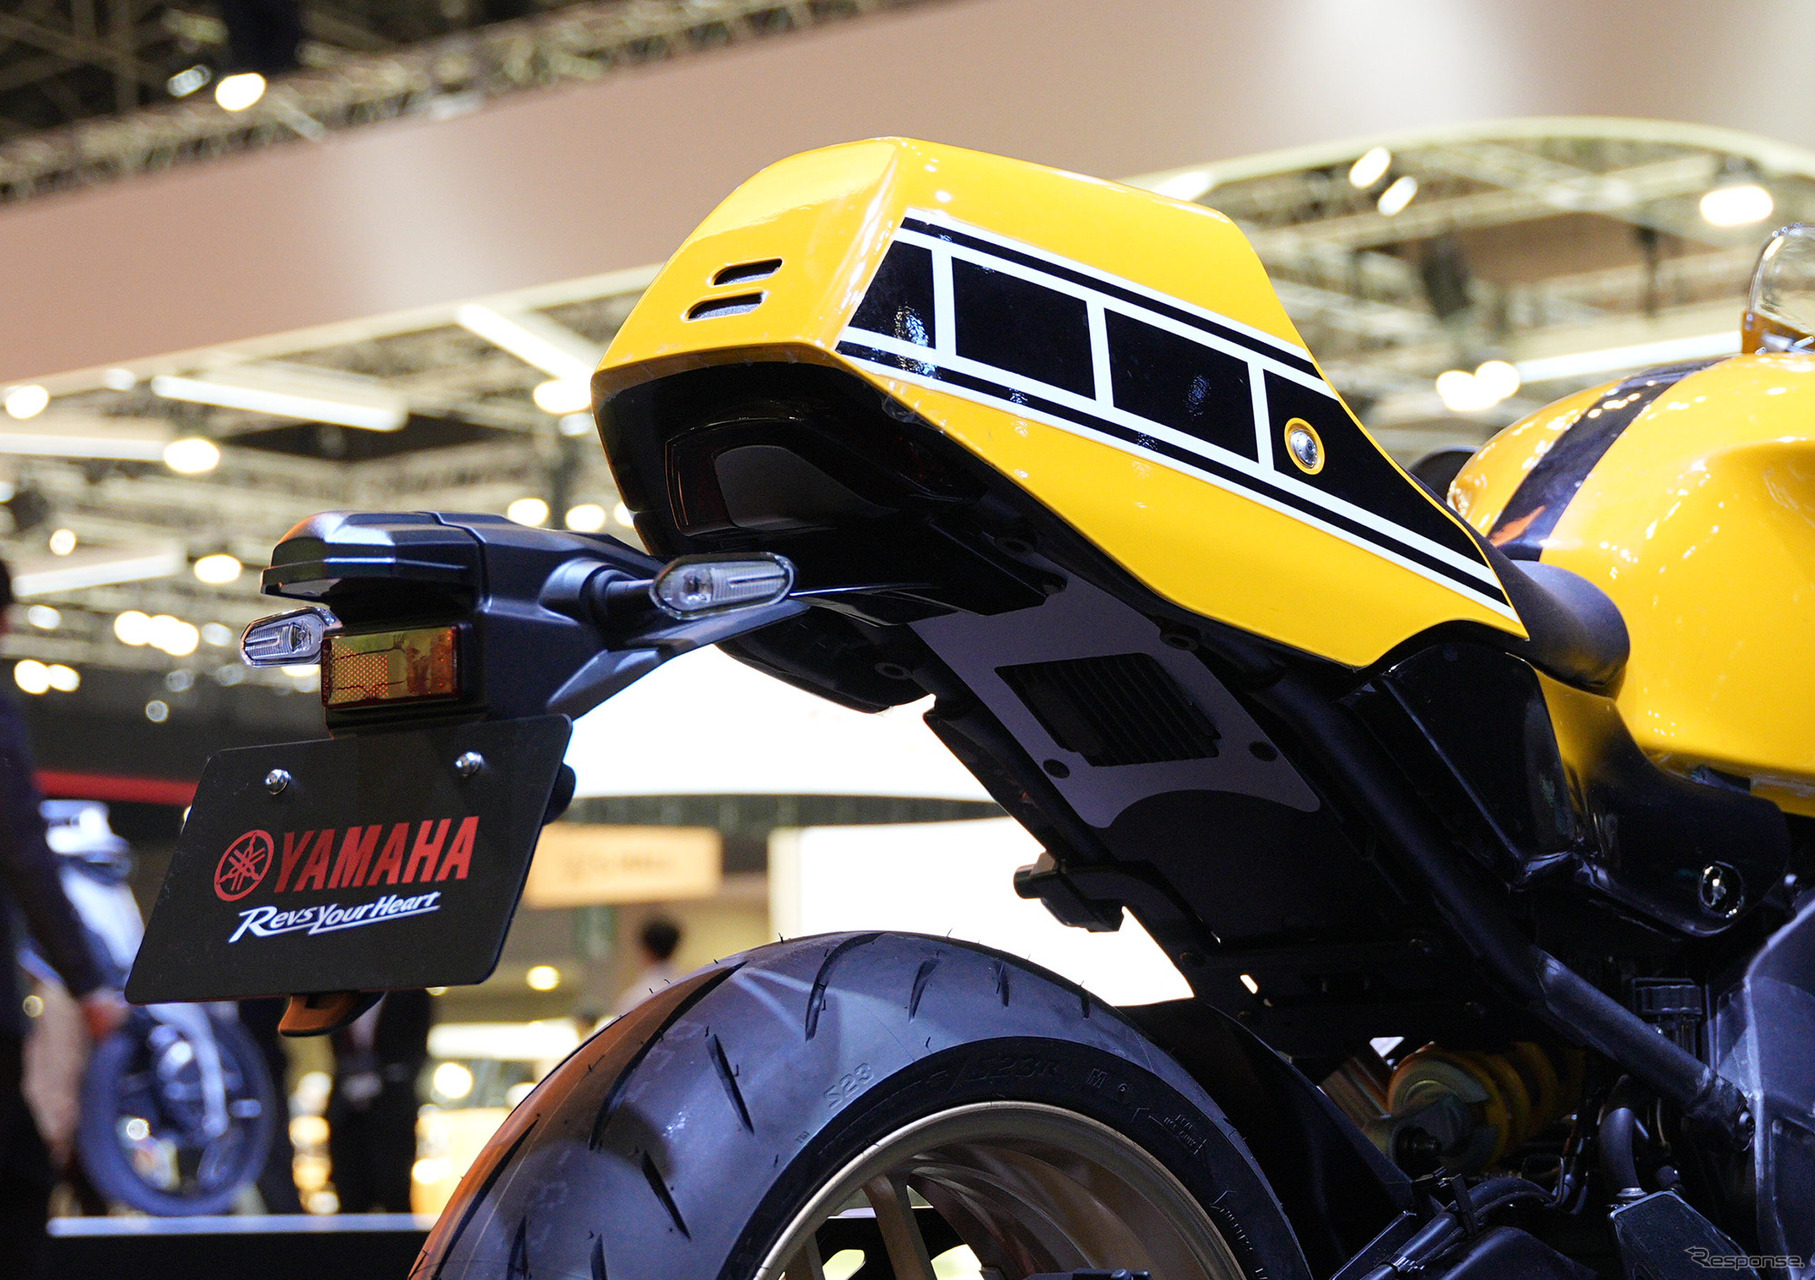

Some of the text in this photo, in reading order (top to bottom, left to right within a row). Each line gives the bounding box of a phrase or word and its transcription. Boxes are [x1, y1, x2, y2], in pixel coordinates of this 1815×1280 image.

[273, 815, 480, 894] YAMAHA
[228, 891, 442, 944] Revs Your Heart
